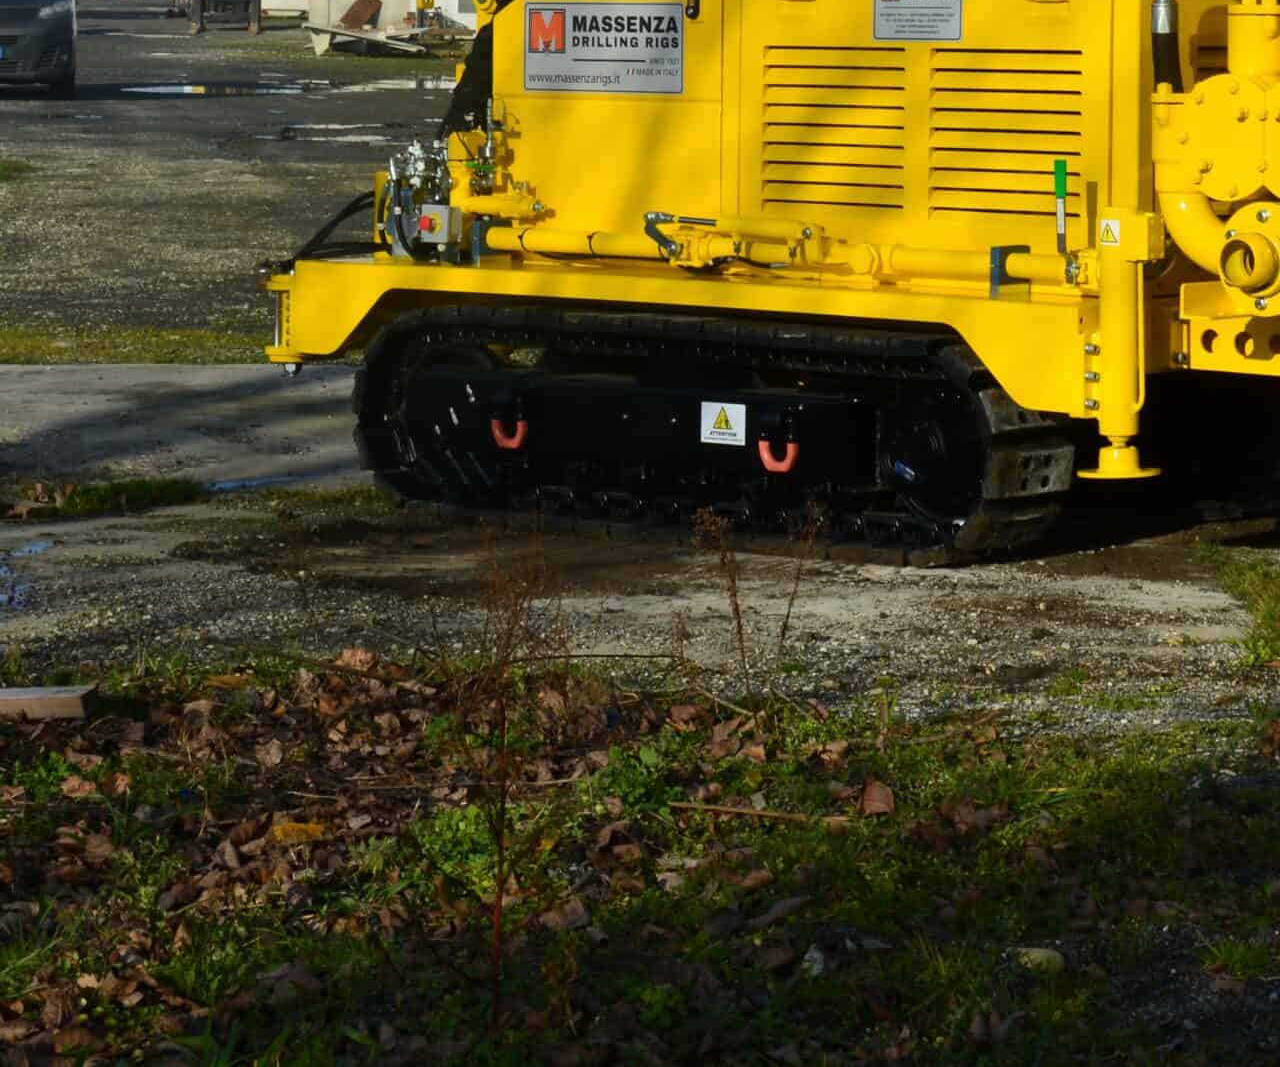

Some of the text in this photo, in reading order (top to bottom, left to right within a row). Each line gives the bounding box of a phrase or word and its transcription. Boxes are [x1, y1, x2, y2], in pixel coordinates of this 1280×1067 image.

[572, 16, 679, 33] MASSENZA
[572, 36, 680, 49] DRILLING RIGS
[528, 74, 621, 87] www.massenzarigs.it
